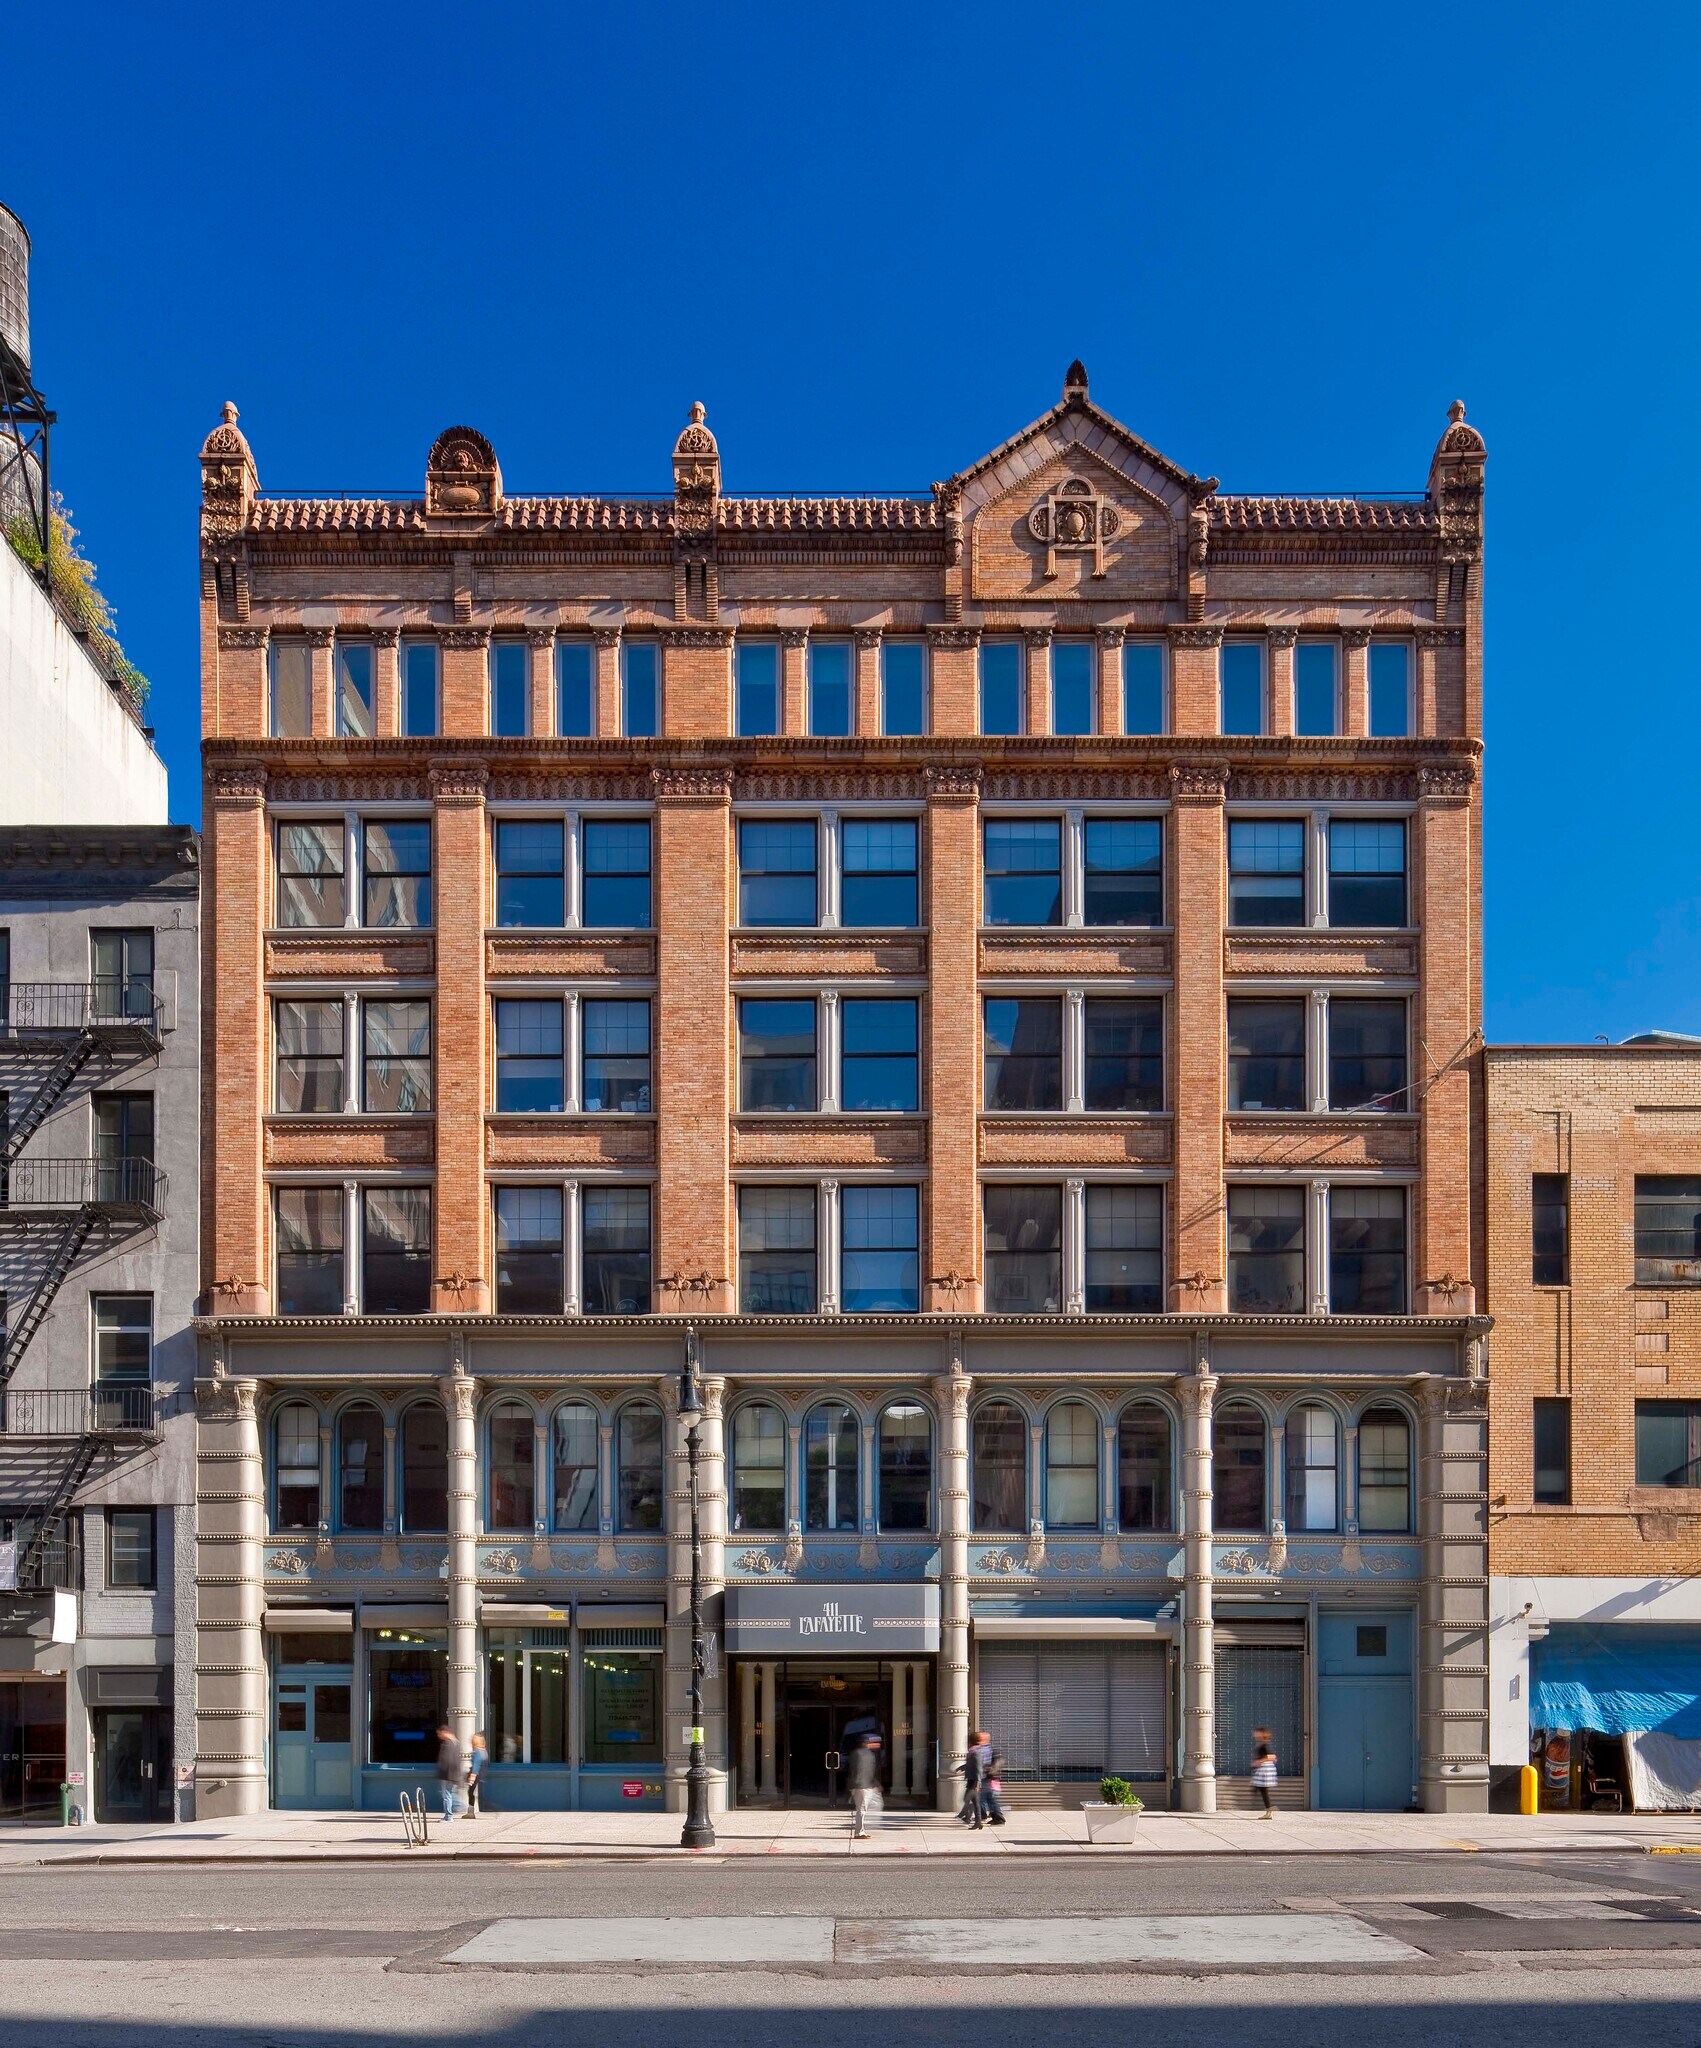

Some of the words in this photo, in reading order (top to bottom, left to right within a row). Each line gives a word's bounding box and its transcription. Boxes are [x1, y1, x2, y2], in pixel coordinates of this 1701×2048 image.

[822, 1602, 839, 1616] 411
[799, 1614, 867, 1635] LAFAYETTE
[0, 1753, 20, 1761] ER
